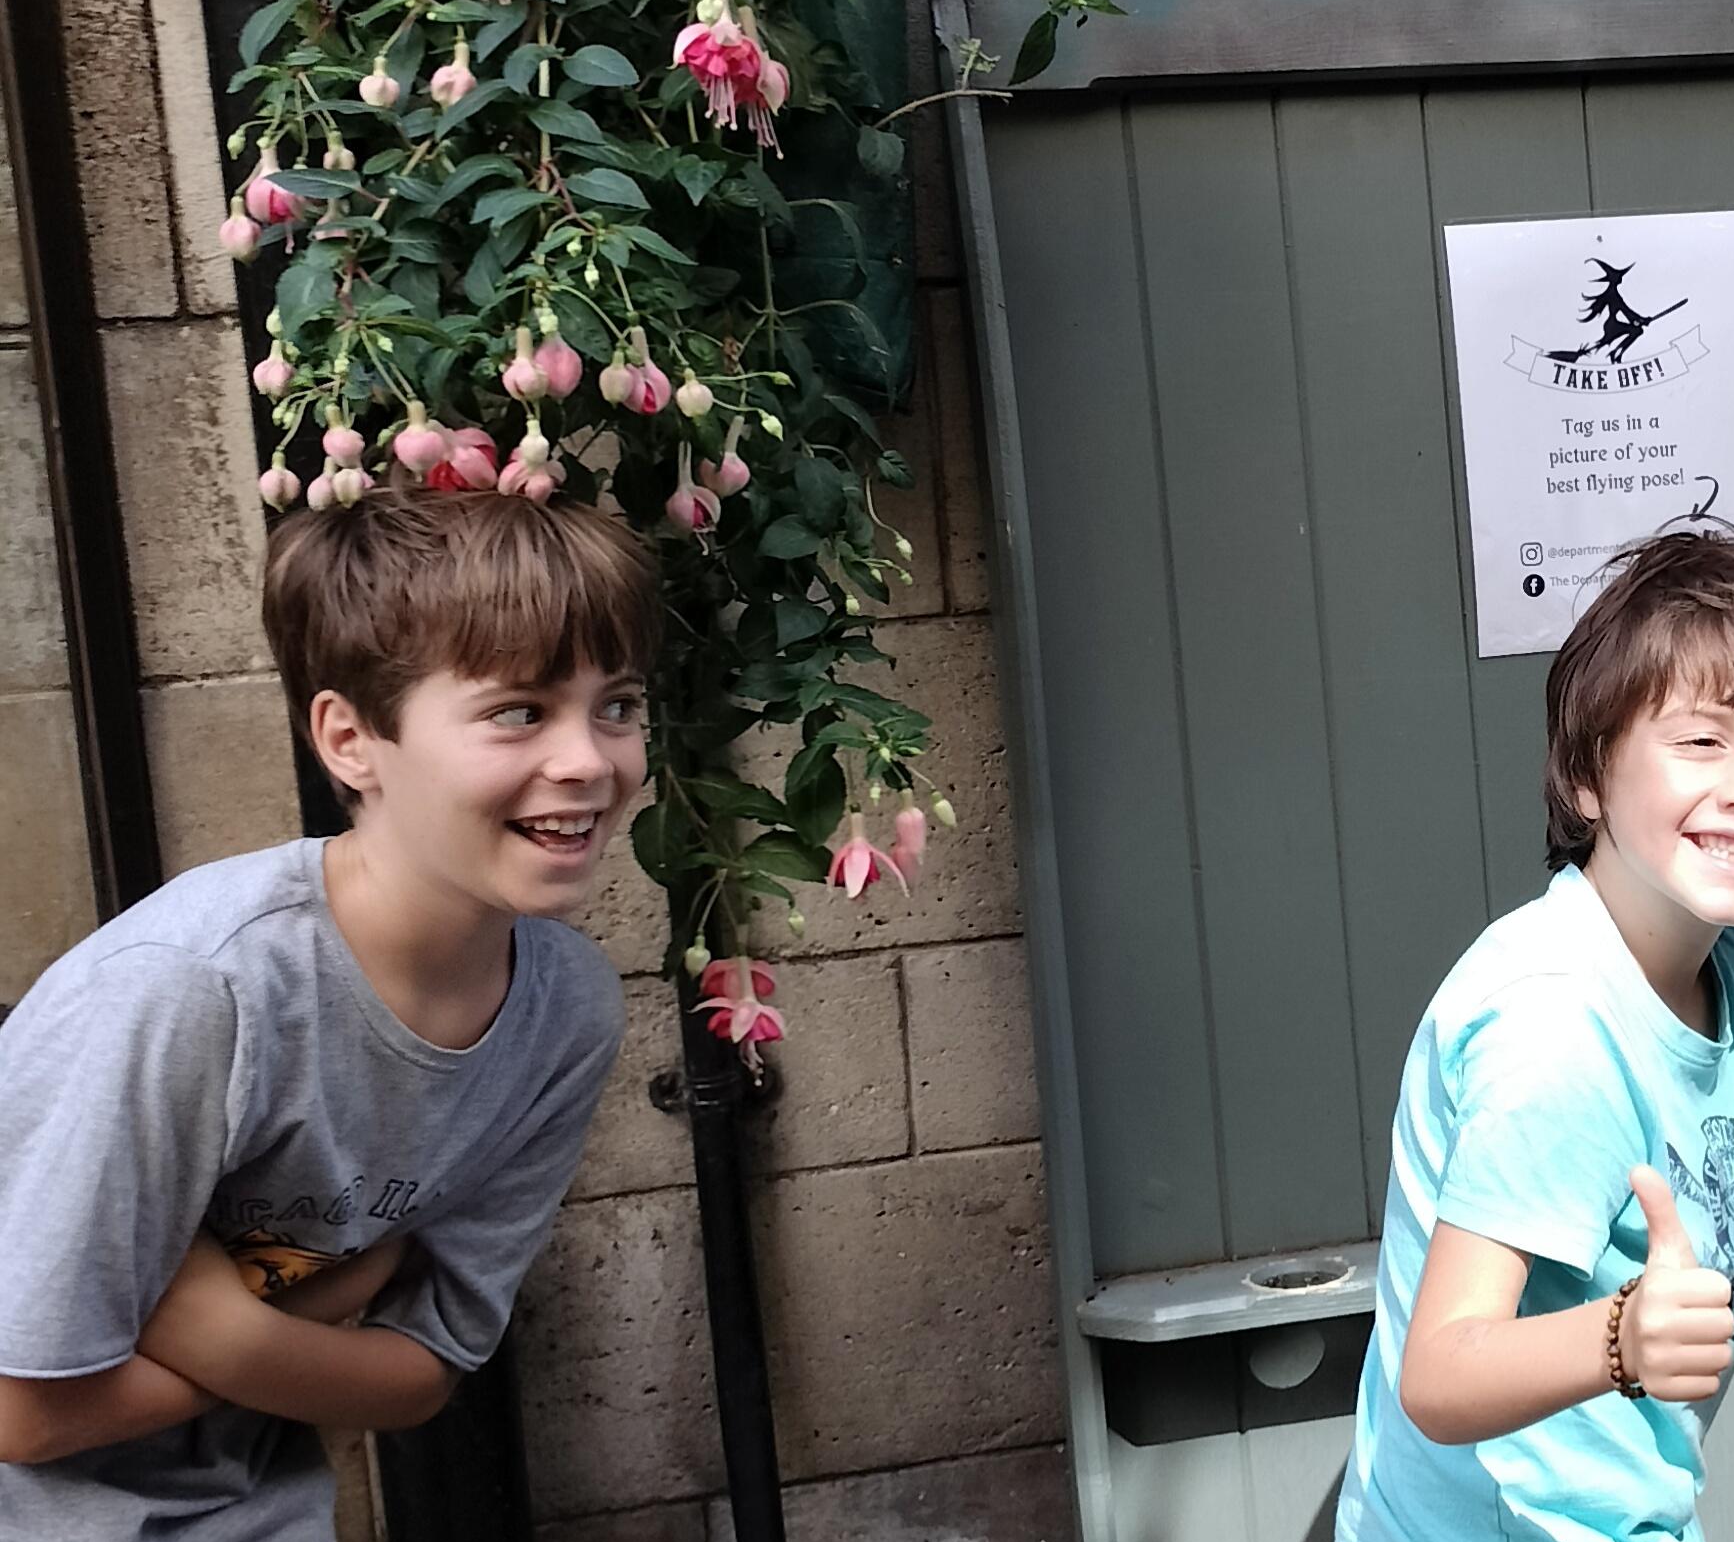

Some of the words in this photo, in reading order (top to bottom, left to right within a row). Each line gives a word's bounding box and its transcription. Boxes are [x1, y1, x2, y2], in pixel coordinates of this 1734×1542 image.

[1553, 362, 1608, 390] TAKE
[1617, 357, 1665, 388] OFF!
[1561, 418, 1594, 438] Tag
[1601, 418, 1620, 432] us
[1626, 414, 1642, 431] in
[1648, 416, 1660, 429] a
[1549, 447, 1608, 468] picture
[1614, 442, 1634, 460] of
[1638, 443, 1678, 463] your
[1546, 476, 1580, 494] best
[1586, 473, 1635, 495] flying
[1641, 467, 1685, 491] pose!
[1549, 575, 1570, 587] The
